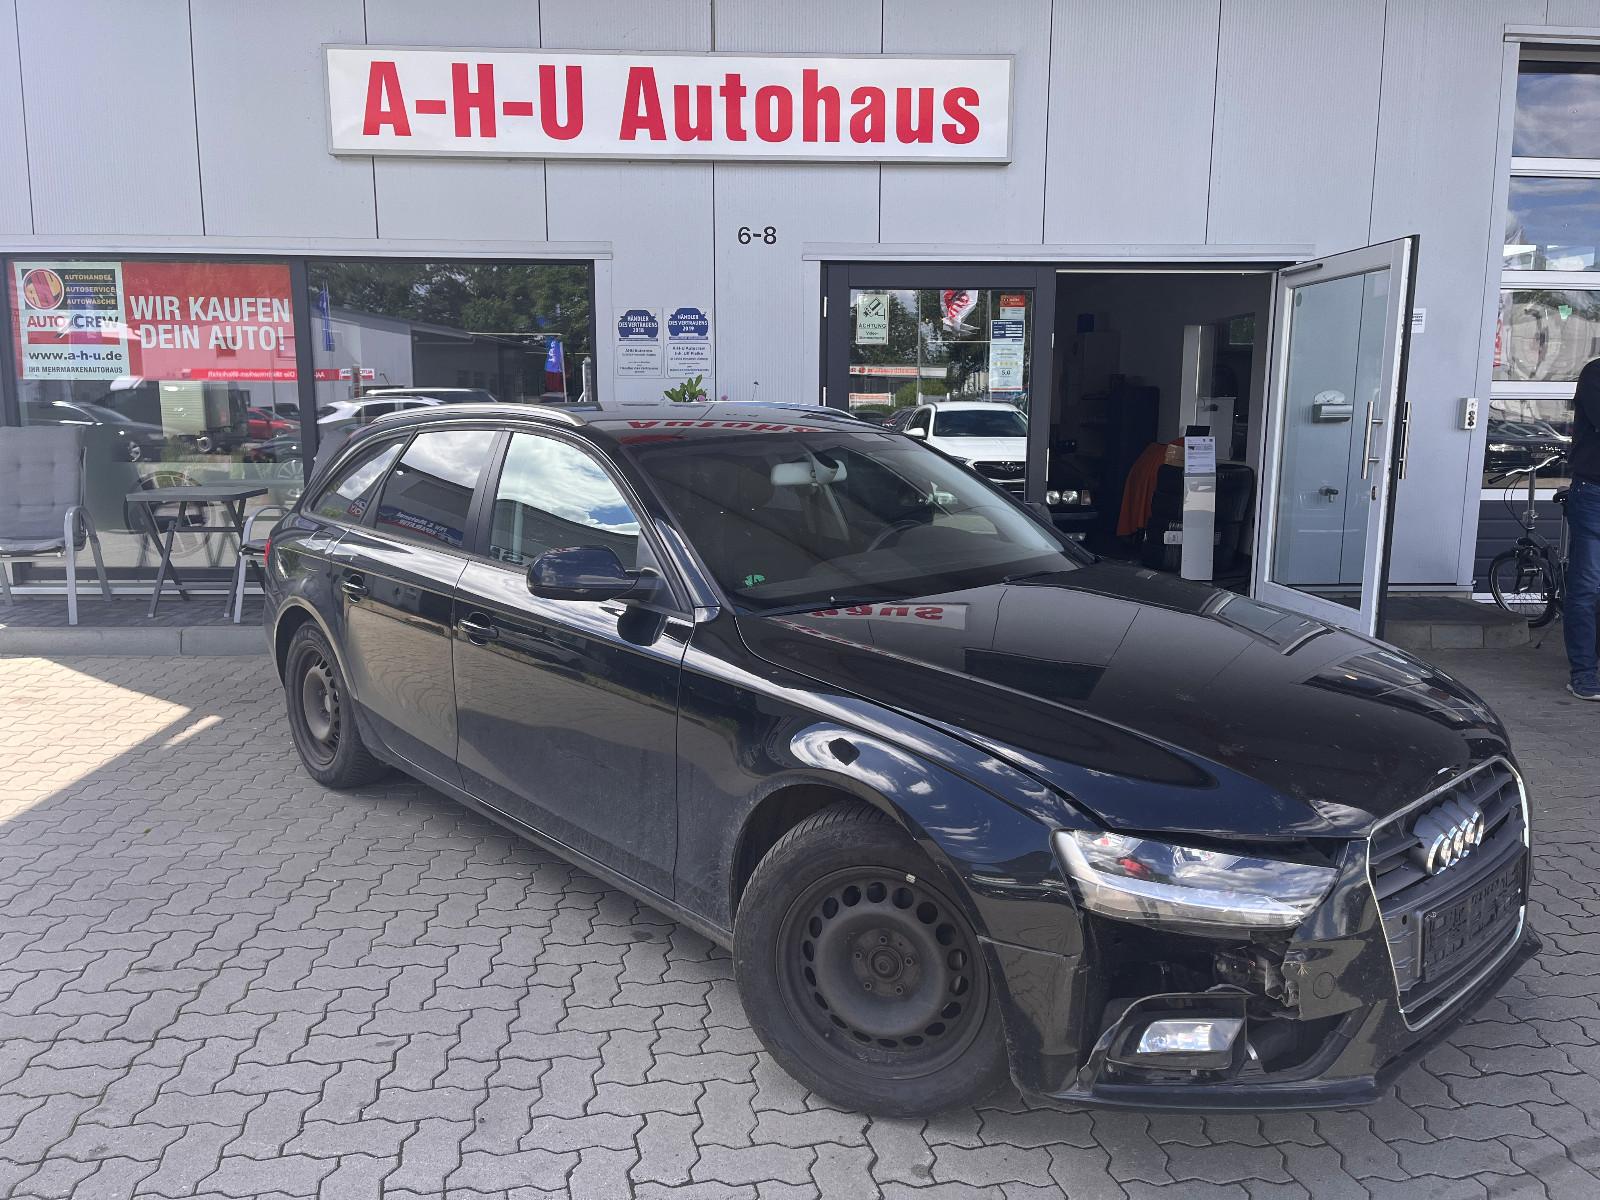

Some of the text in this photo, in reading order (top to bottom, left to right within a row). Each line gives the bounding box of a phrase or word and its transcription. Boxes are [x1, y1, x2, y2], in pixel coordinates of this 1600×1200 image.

[361, 60, 980, 145] A-H-U Autohaus
[737, 226, 777, 245] 6-8
[129, 295, 291, 323] WIR KAUFEN
[27, 315, 65, 328] AUTO
[140, 324, 285, 351] DEIN AUTO!
[28, 350, 123, 361] www.a-h-u.de
[41, 366, 123, 374] MEHRMARKENAUTOHAUS
